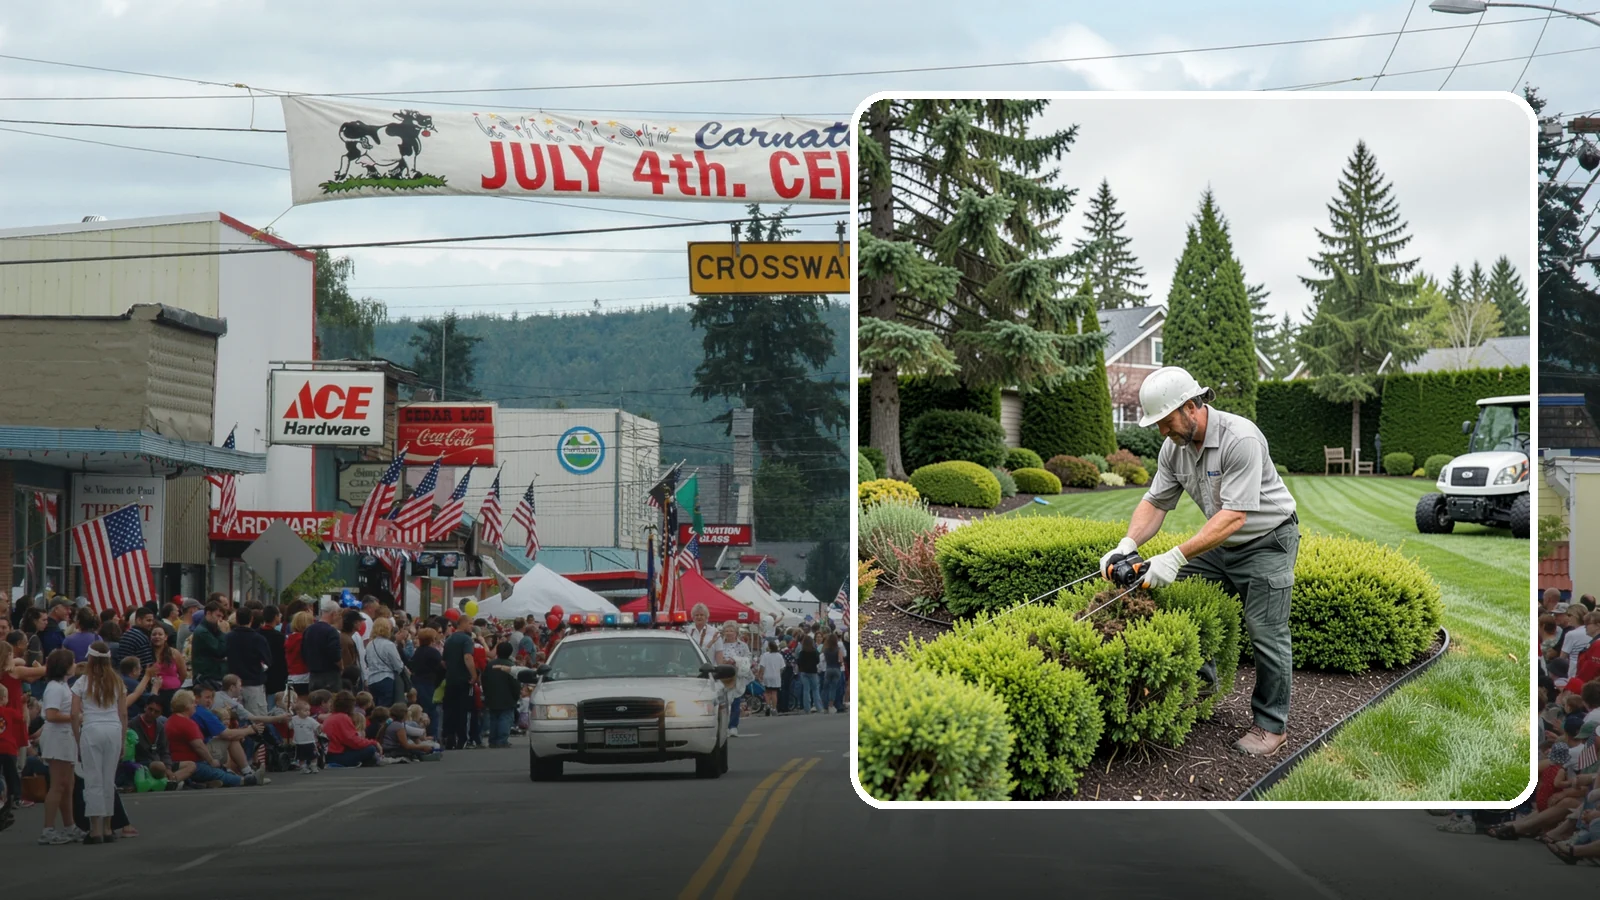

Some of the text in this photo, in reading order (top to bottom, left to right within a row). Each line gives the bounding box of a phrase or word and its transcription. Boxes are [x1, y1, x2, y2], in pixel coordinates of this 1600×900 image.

[695, 121, 850, 150] Carnat
[481, 141, 604, 192] JULY
[633, 149, 747, 197] 4th.
[697, 254, 850, 280] CROSSWA
[283, 380, 373, 420] ACE
[406, 409, 485, 422] CEDAR LOG
[283, 421, 370, 436] Hardware
[416, 428, 477, 447] Coca-Cola
[354, 468, 385, 480] Simpl
[83, 485, 155, 496] St. Vincent de Paul
[213, 516, 330, 536] HARDARE
[688, 526, 741, 535] CRNATION
[699, 535, 730, 543] GLASS
